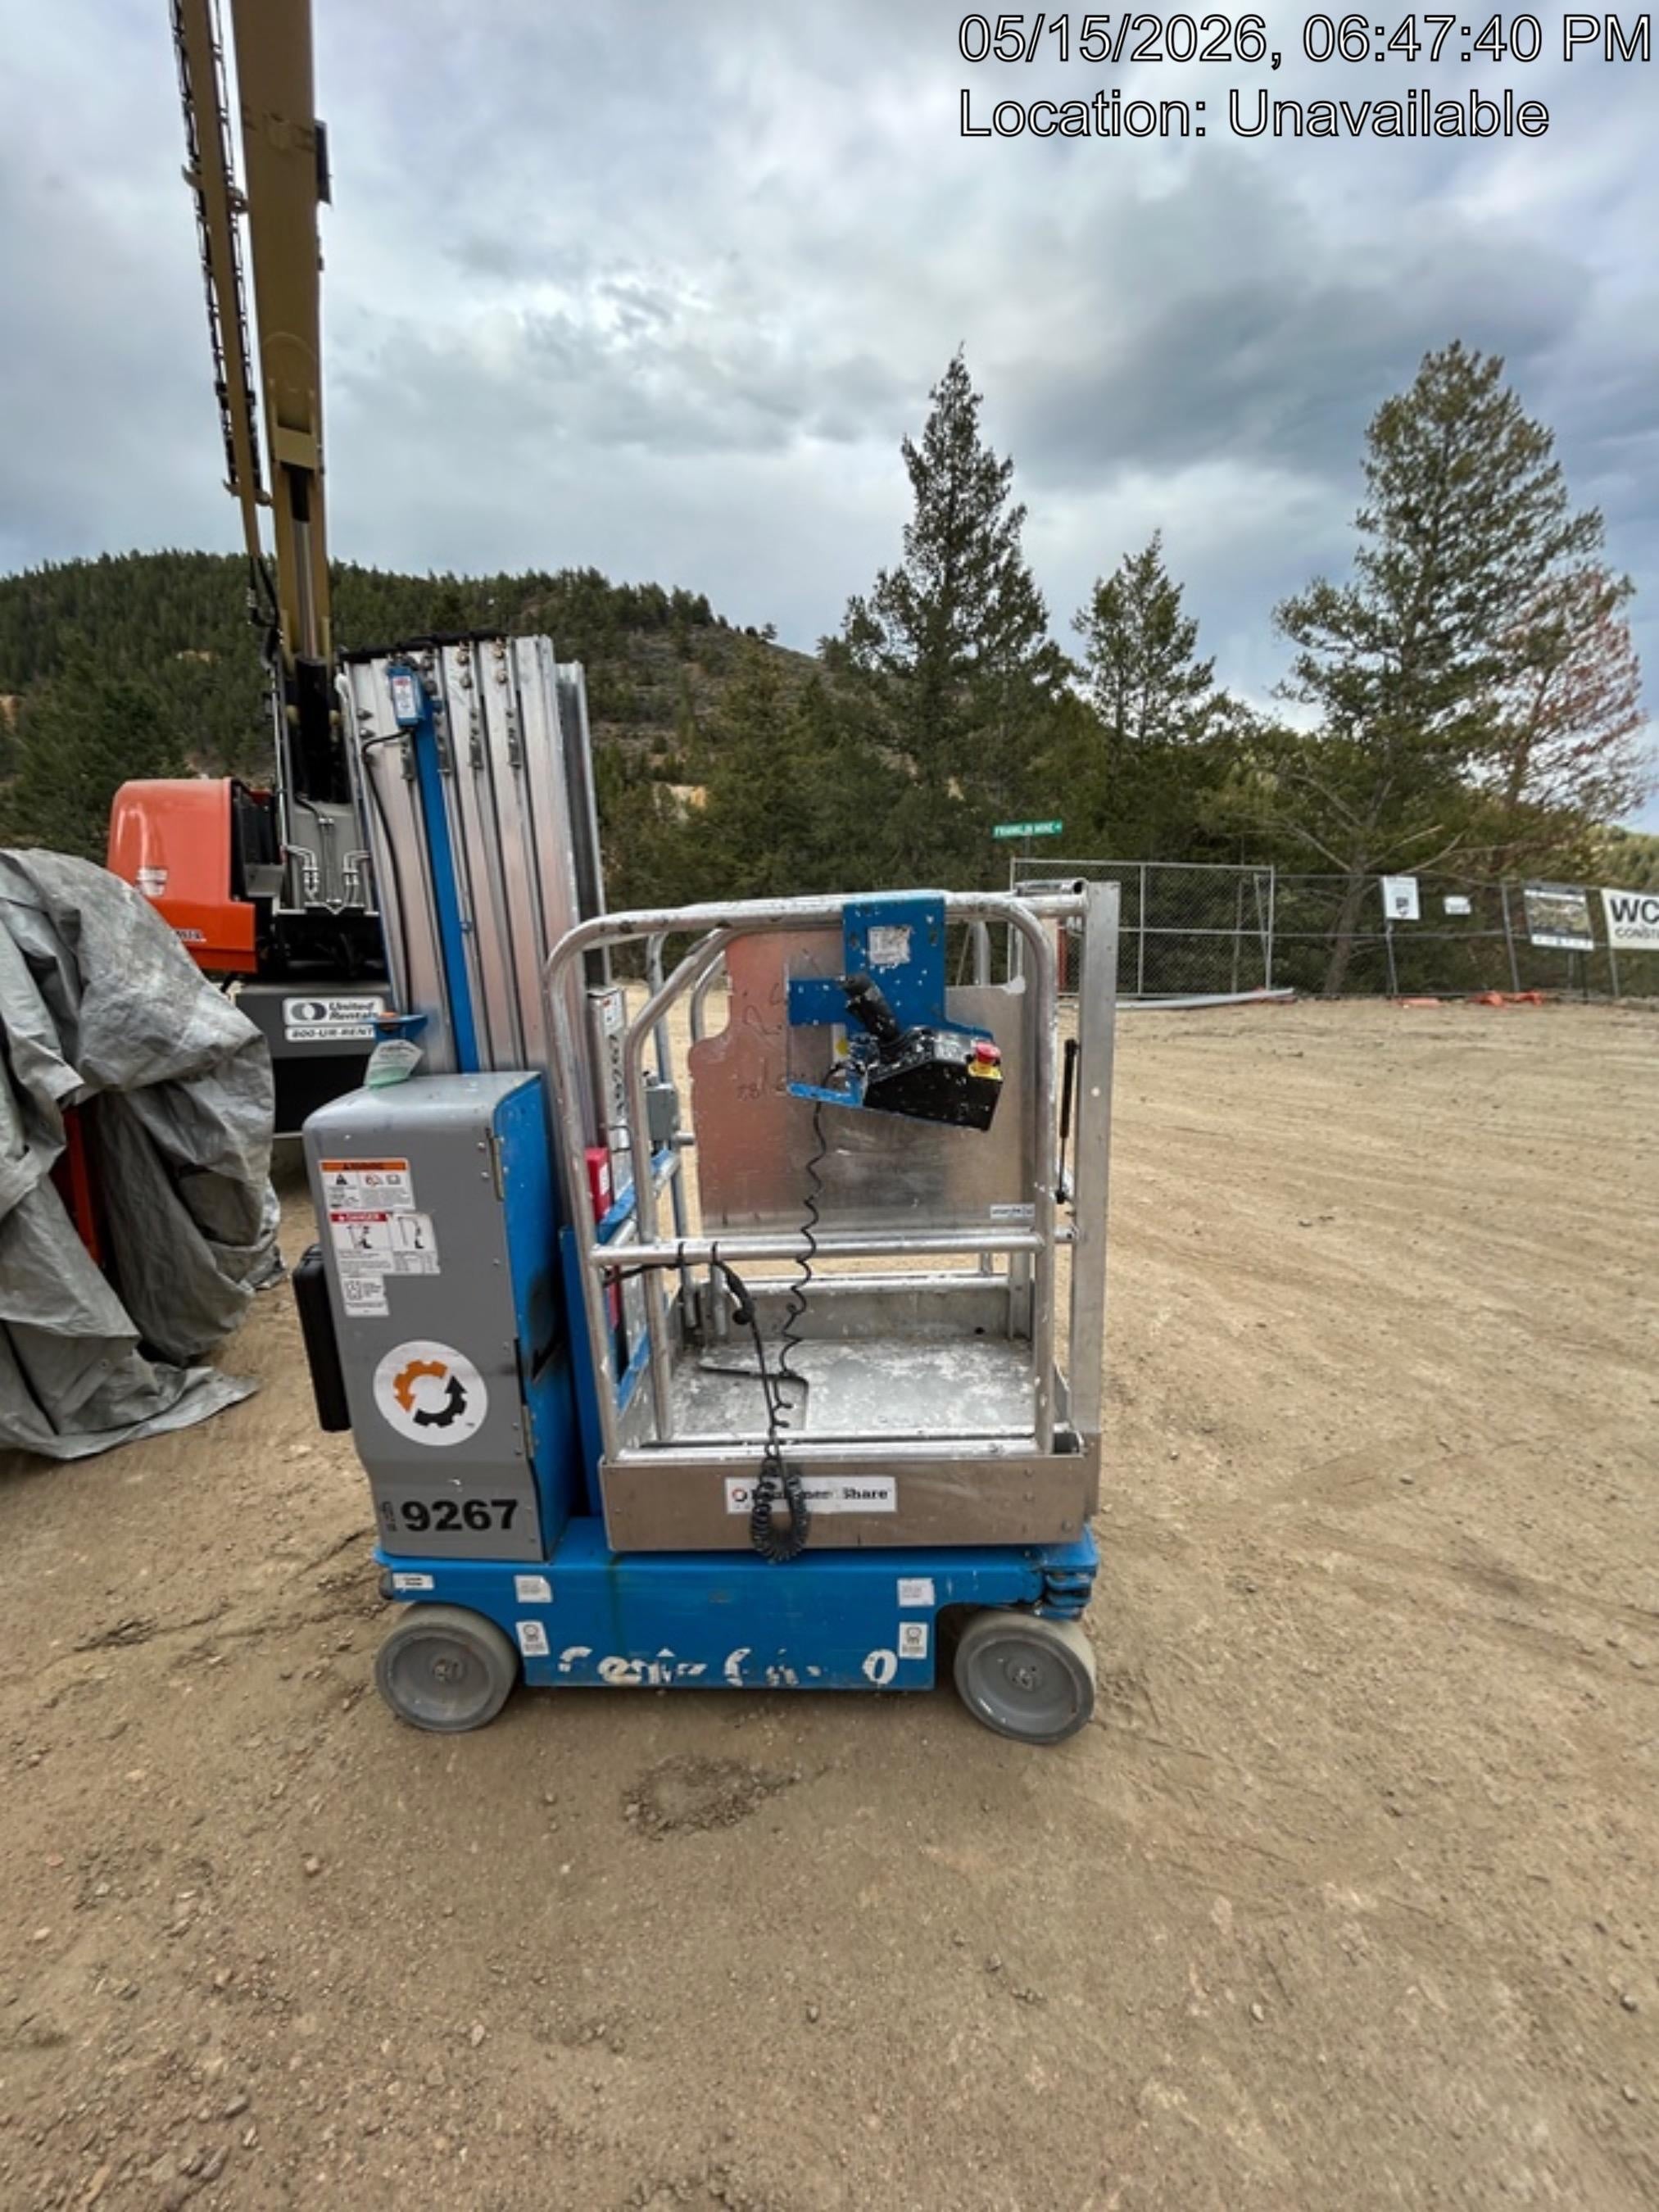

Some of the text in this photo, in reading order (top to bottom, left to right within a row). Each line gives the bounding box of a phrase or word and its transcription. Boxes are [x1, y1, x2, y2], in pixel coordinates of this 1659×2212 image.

[1614, 927, 1659, 940] CONST
[329, 1002, 374, 1010] United
[329, 1012, 378, 1021] Rental
[842, 1487, 888, 1499] Share
[401, 1498, 519, 1531] 9267
